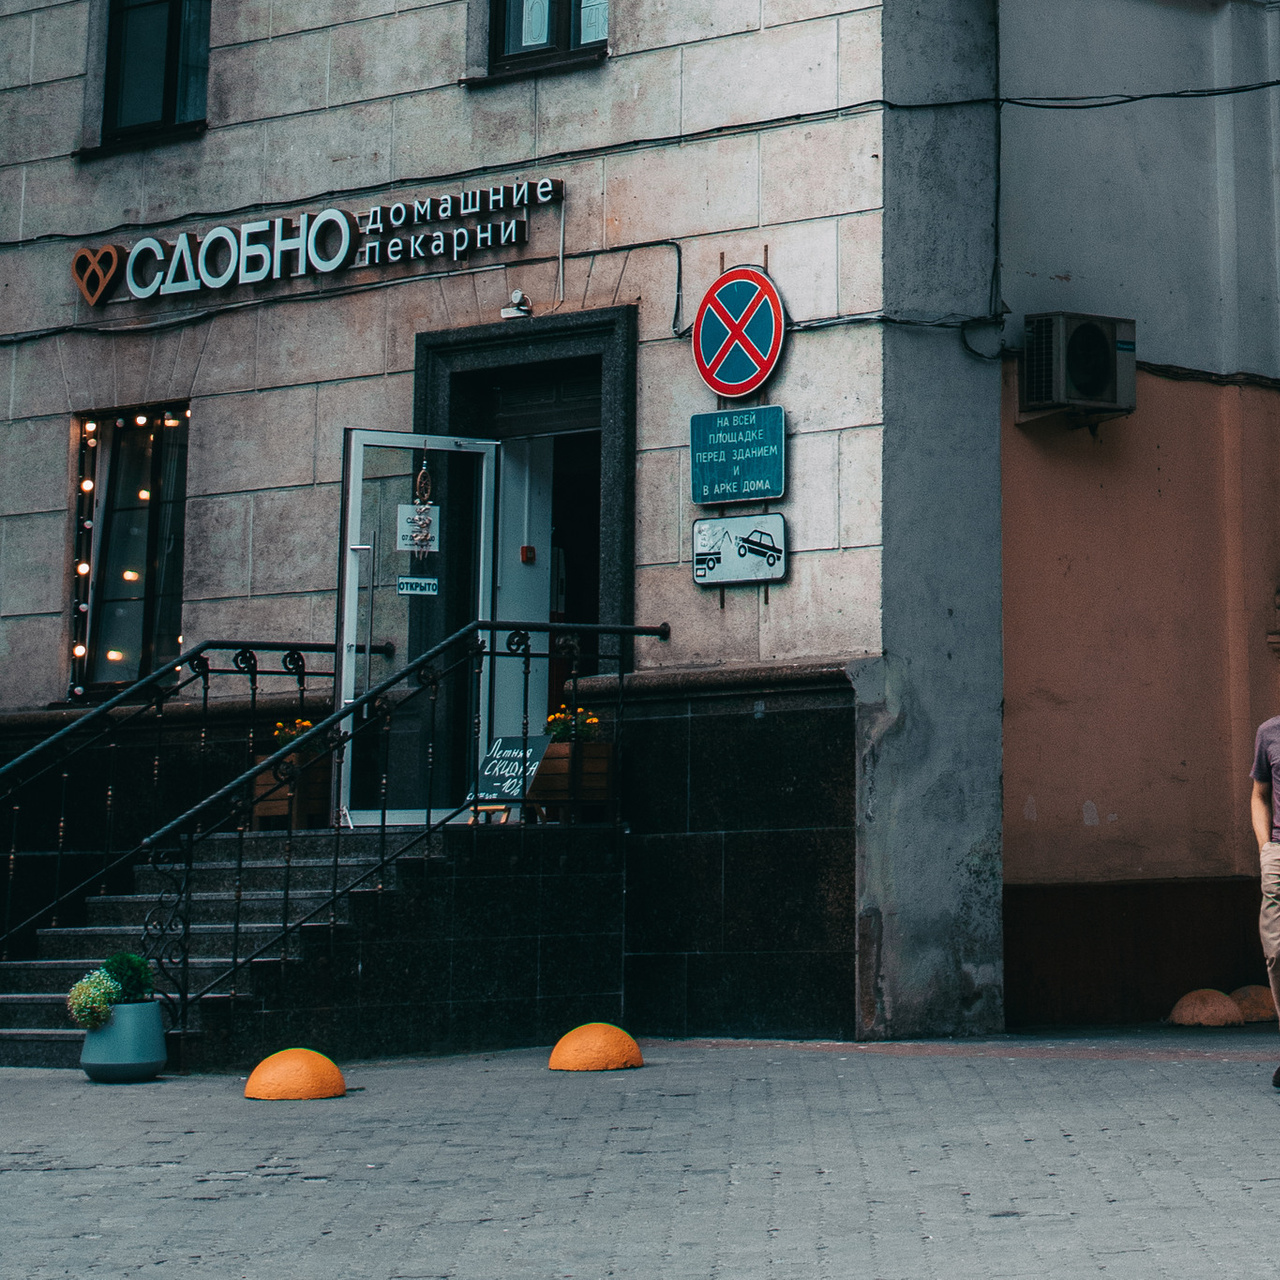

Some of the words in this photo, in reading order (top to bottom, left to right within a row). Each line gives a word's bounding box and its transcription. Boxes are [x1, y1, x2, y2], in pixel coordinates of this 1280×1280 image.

[366, 178, 553, 234] домашние
[365, 220, 517, 265] пекарни
[126, 208, 350, 299] СДОБНО
[717, 417, 730, 428] НА
[733, 411, 756, 426] ВСЕЙ
[709, 429, 764, 445] ПЛОЩАДКЕ
[696, 450, 726, 463] ПЕРЕД
[732, 445, 778, 460] ЗДАНИЕМ
[733, 465, 740, 476] И
[703, 485, 709, 496] В
[713, 481, 738, 495] АРКЕ
[742, 479, 771, 493] ДОМА
[399, 581, 438, 592] ОТКРЫТО
